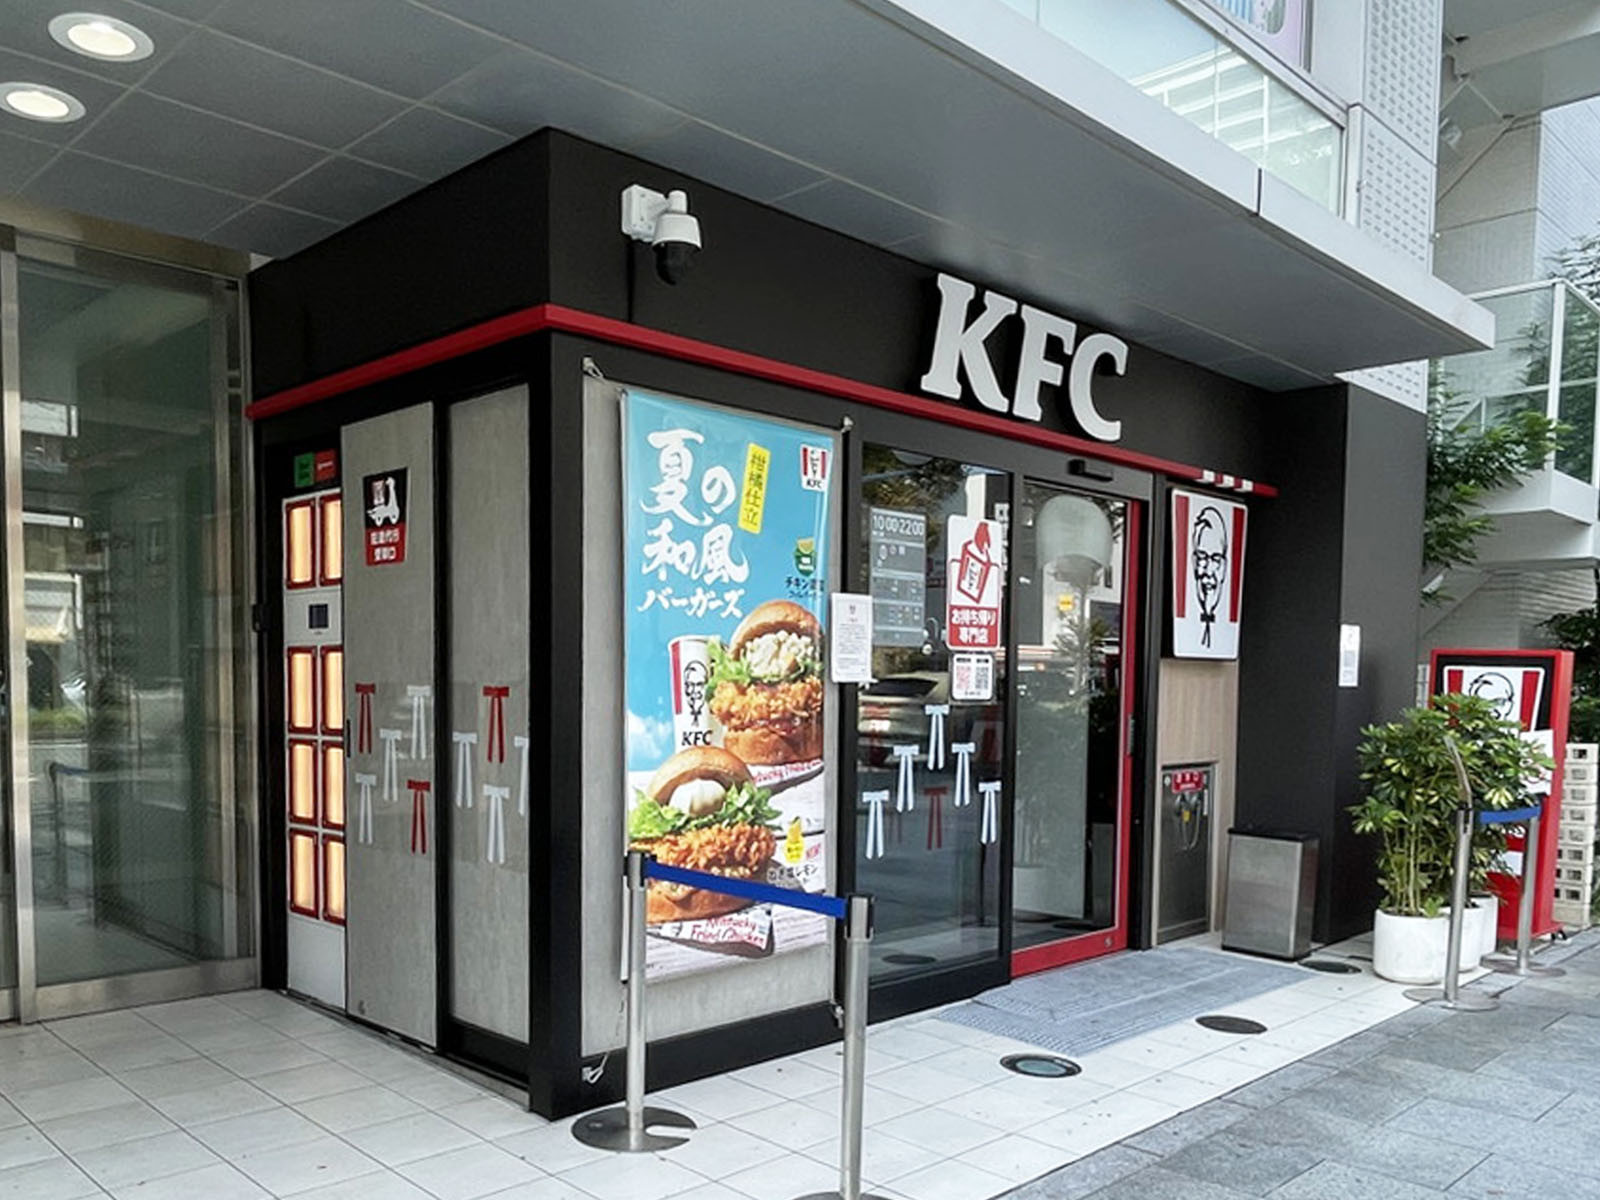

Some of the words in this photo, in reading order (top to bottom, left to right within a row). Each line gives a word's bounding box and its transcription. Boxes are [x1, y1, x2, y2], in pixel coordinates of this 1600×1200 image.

[921, 272, 1129, 442] KFC
[640, 428, 736, 526] 夏の
[641, 518, 748, 584] 和風
[637, 588, 745, 618] バーガーズ
[681, 730, 713, 746] KFC
